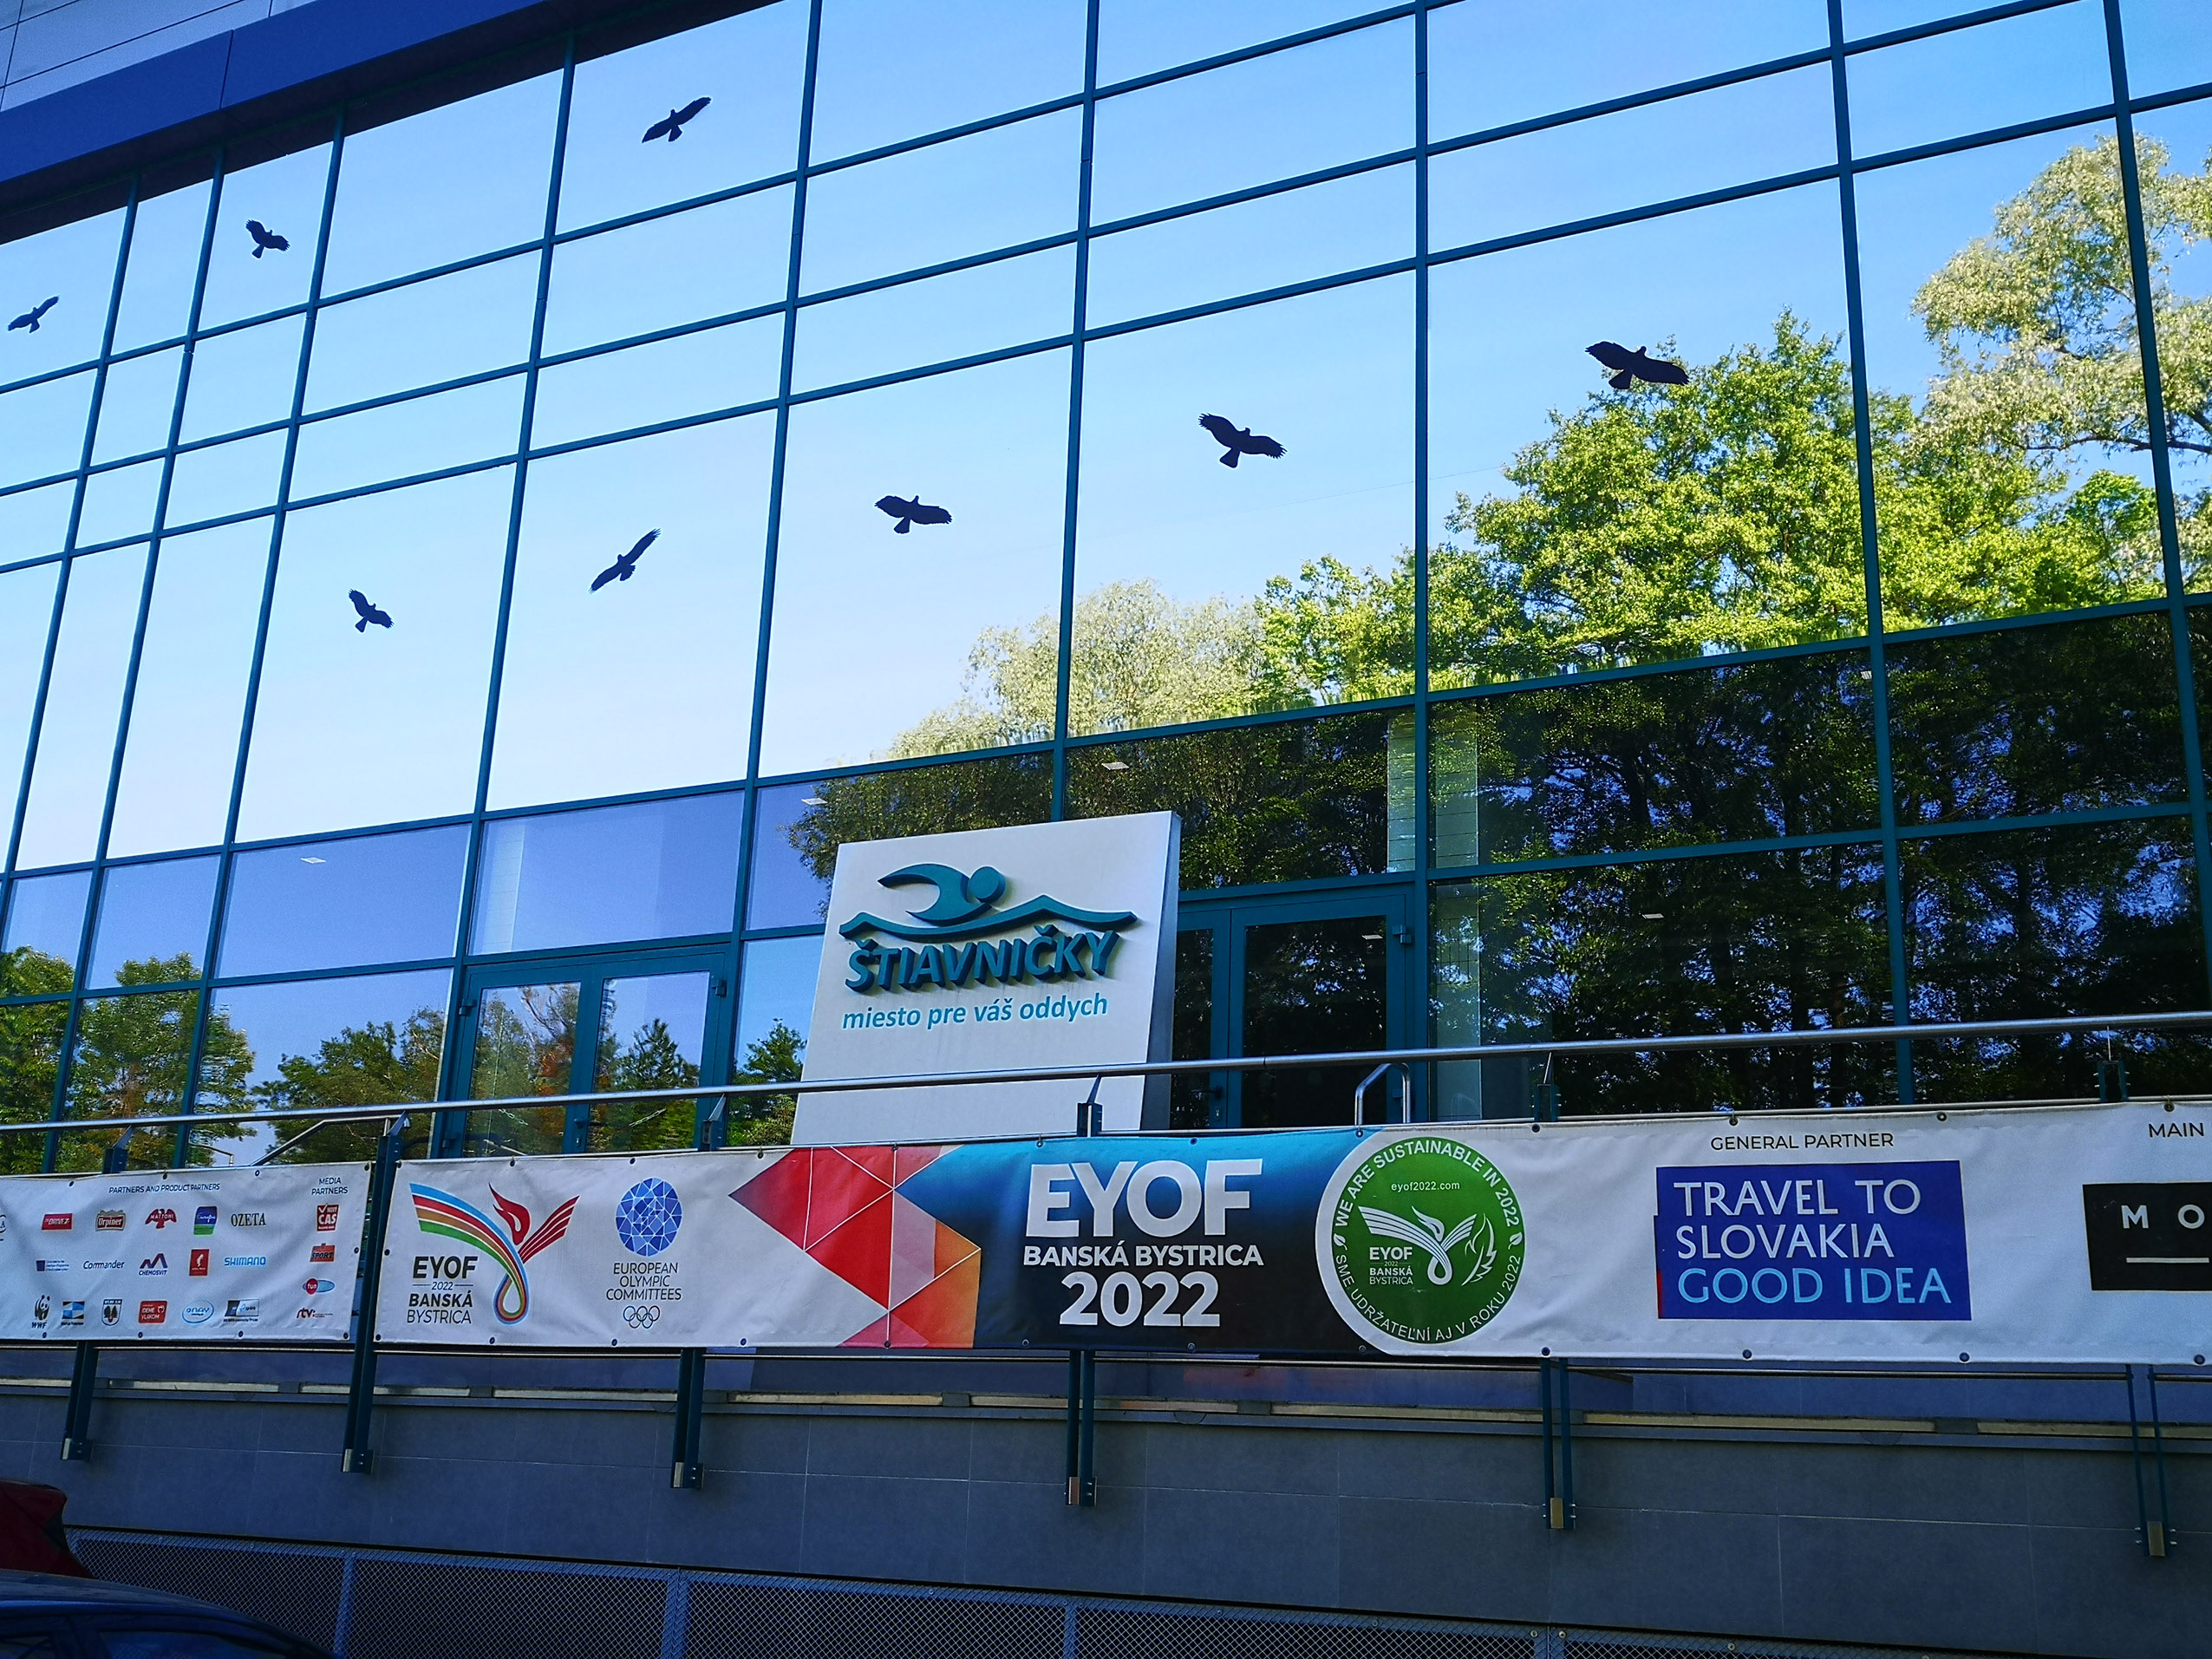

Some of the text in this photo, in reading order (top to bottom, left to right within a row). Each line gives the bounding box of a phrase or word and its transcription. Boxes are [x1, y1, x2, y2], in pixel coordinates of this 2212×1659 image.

[845, 924, 1119, 993] ŠTIAVNIČKY
[843, 992, 1107, 1030] miesto pre váš oddych
[2148, 1122, 2205, 1138] MAIN
[1711, 1133, 1894, 1151] GENERAL PARTNER
[109, 1185, 145, 1194] PARTNERS
[311, 1186, 348, 1195] PARTNERS
[1335, 1140, 1519, 1227] WE ARE SUSTAINABLE IN 2022
[1391, 1181, 1460, 1193] eyof2022.com
[1026, 1159, 1263, 1238] EYOF
[1674, 1179, 1922, 1217] TRAVEL TO
[231, 1212, 266, 1226] OZETA
[1677, 1223, 1895, 1259] SLOVAKIA
[1023, 1240, 1263, 1267] BANSKÁ BYSTRICA
[1369, 1246, 1413, 1260] EYOF
[82, 1259, 125, 1270] Commander
[225, 1256, 266, 1266] SHIMANO
[413, 1256, 478, 1279] EYOF
[613, 1262, 679, 1275] EUROPEAN
[1369, 1265, 1413, 1276] BANSKÁ
[431, 1282, 453, 1290] 2022
[619, 1275, 670, 1287] OLYMPIC
[1369, 1277, 1413, 1285] BYSTRICA
[1678, 1267, 1952, 1304] GOOD IDEA
[408, 1290, 473, 1308] BANSKÁ
[606, 1288, 682, 1300] COMMITTEES
[1060, 1271, 1221, 1327] 2022
[1335, 1254, 1521, 1342] SME UDRŽATEĽNÍ AJ V ROKU 2022
[407, 1309, 472, 1324] BYSTRICA
